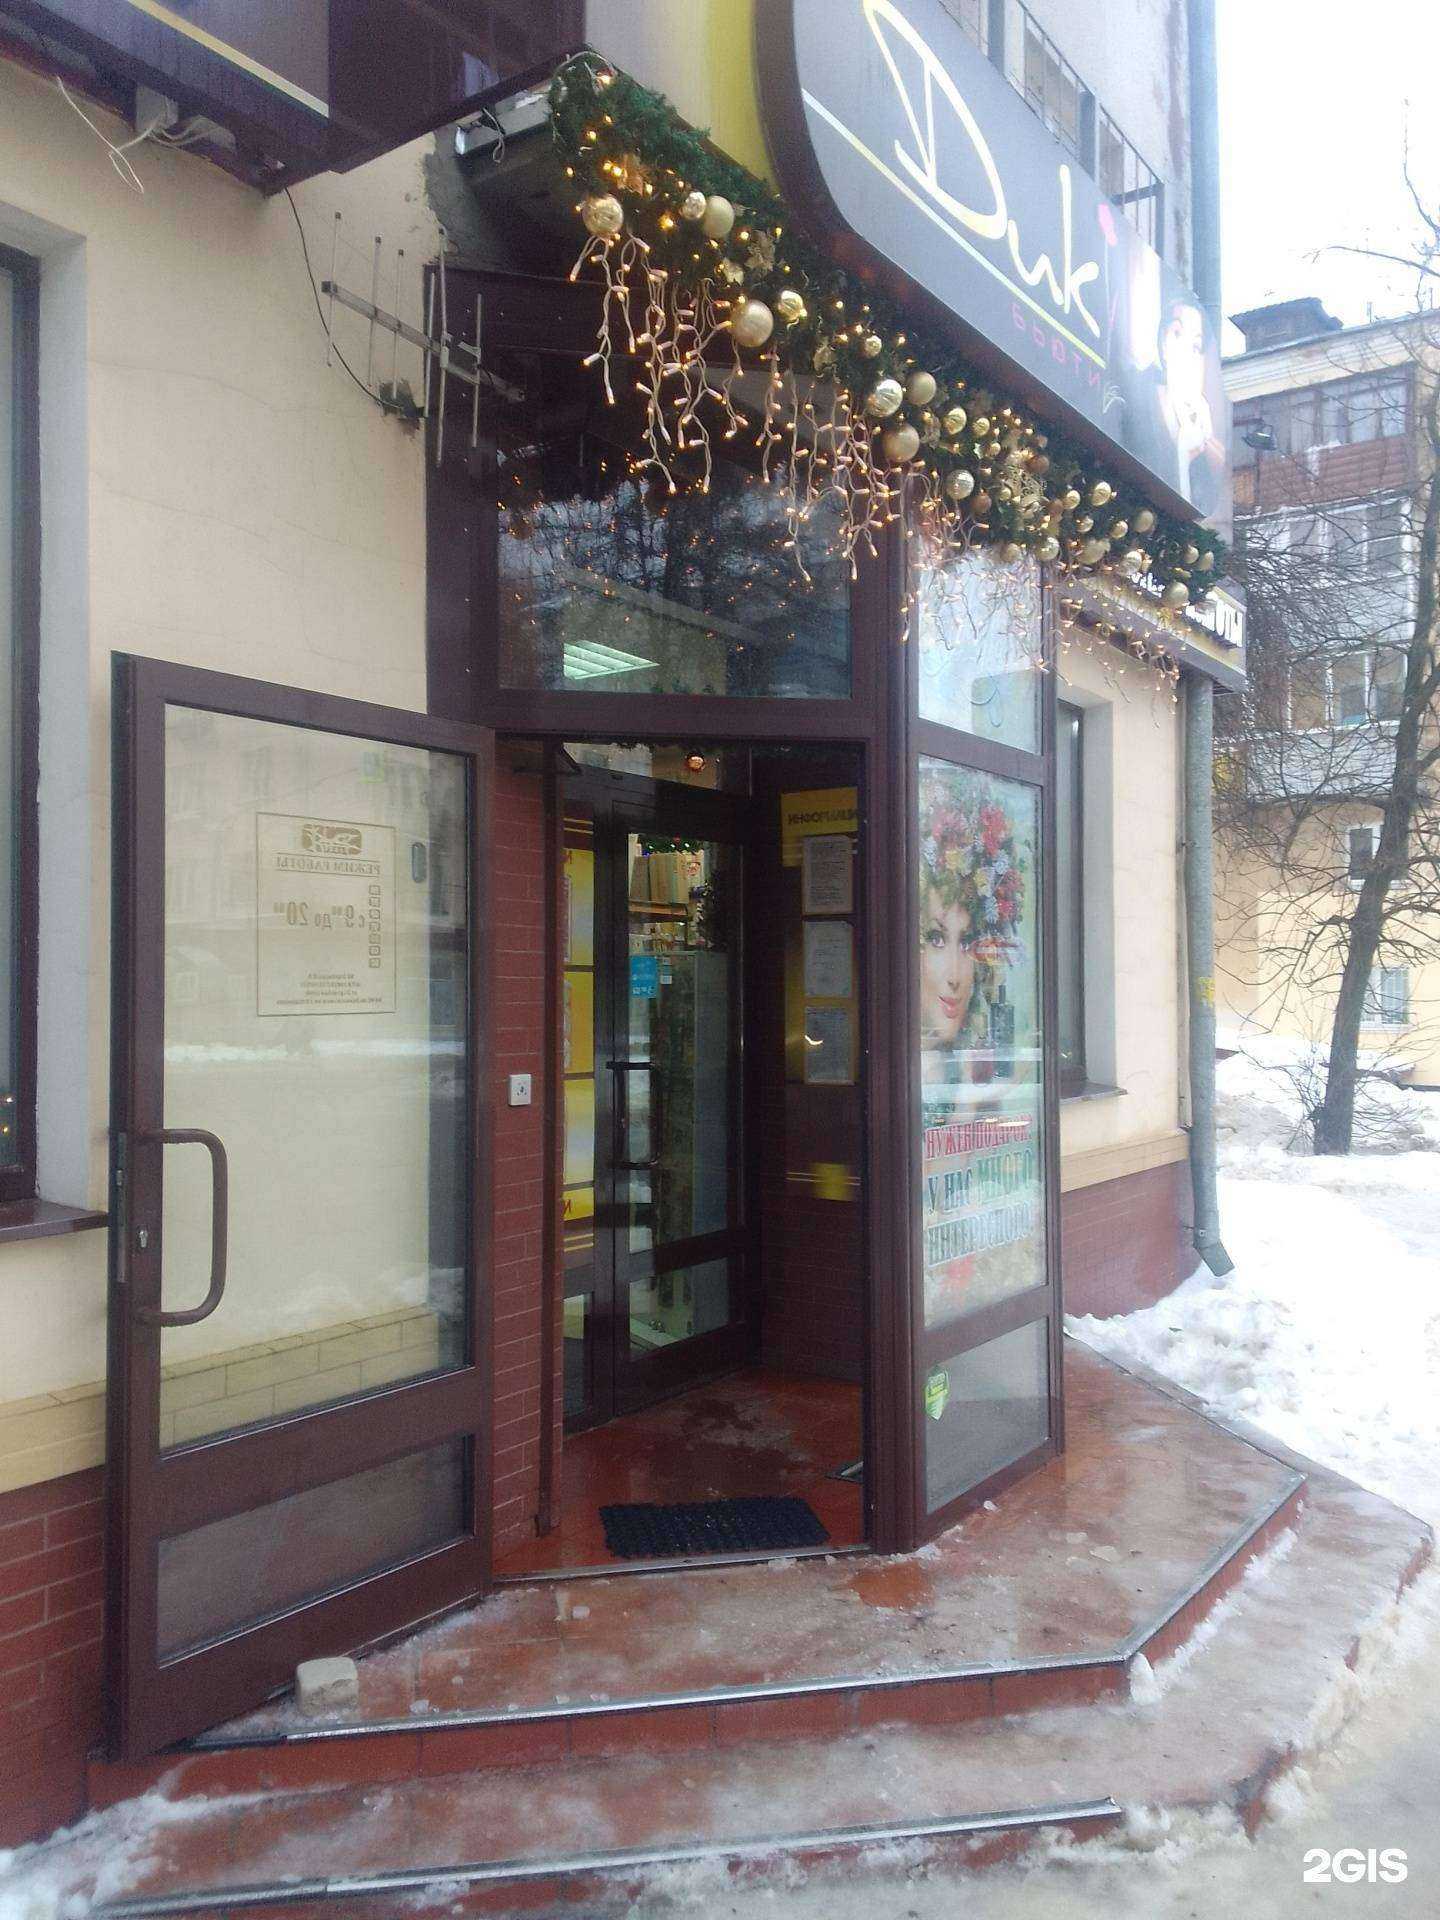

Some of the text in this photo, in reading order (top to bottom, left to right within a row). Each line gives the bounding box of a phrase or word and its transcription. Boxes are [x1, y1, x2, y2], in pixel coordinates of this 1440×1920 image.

[925, 1123, 973, 1158] НУЖЕН
[926, 1149, 1032, 1214] У НАС МНОГО
